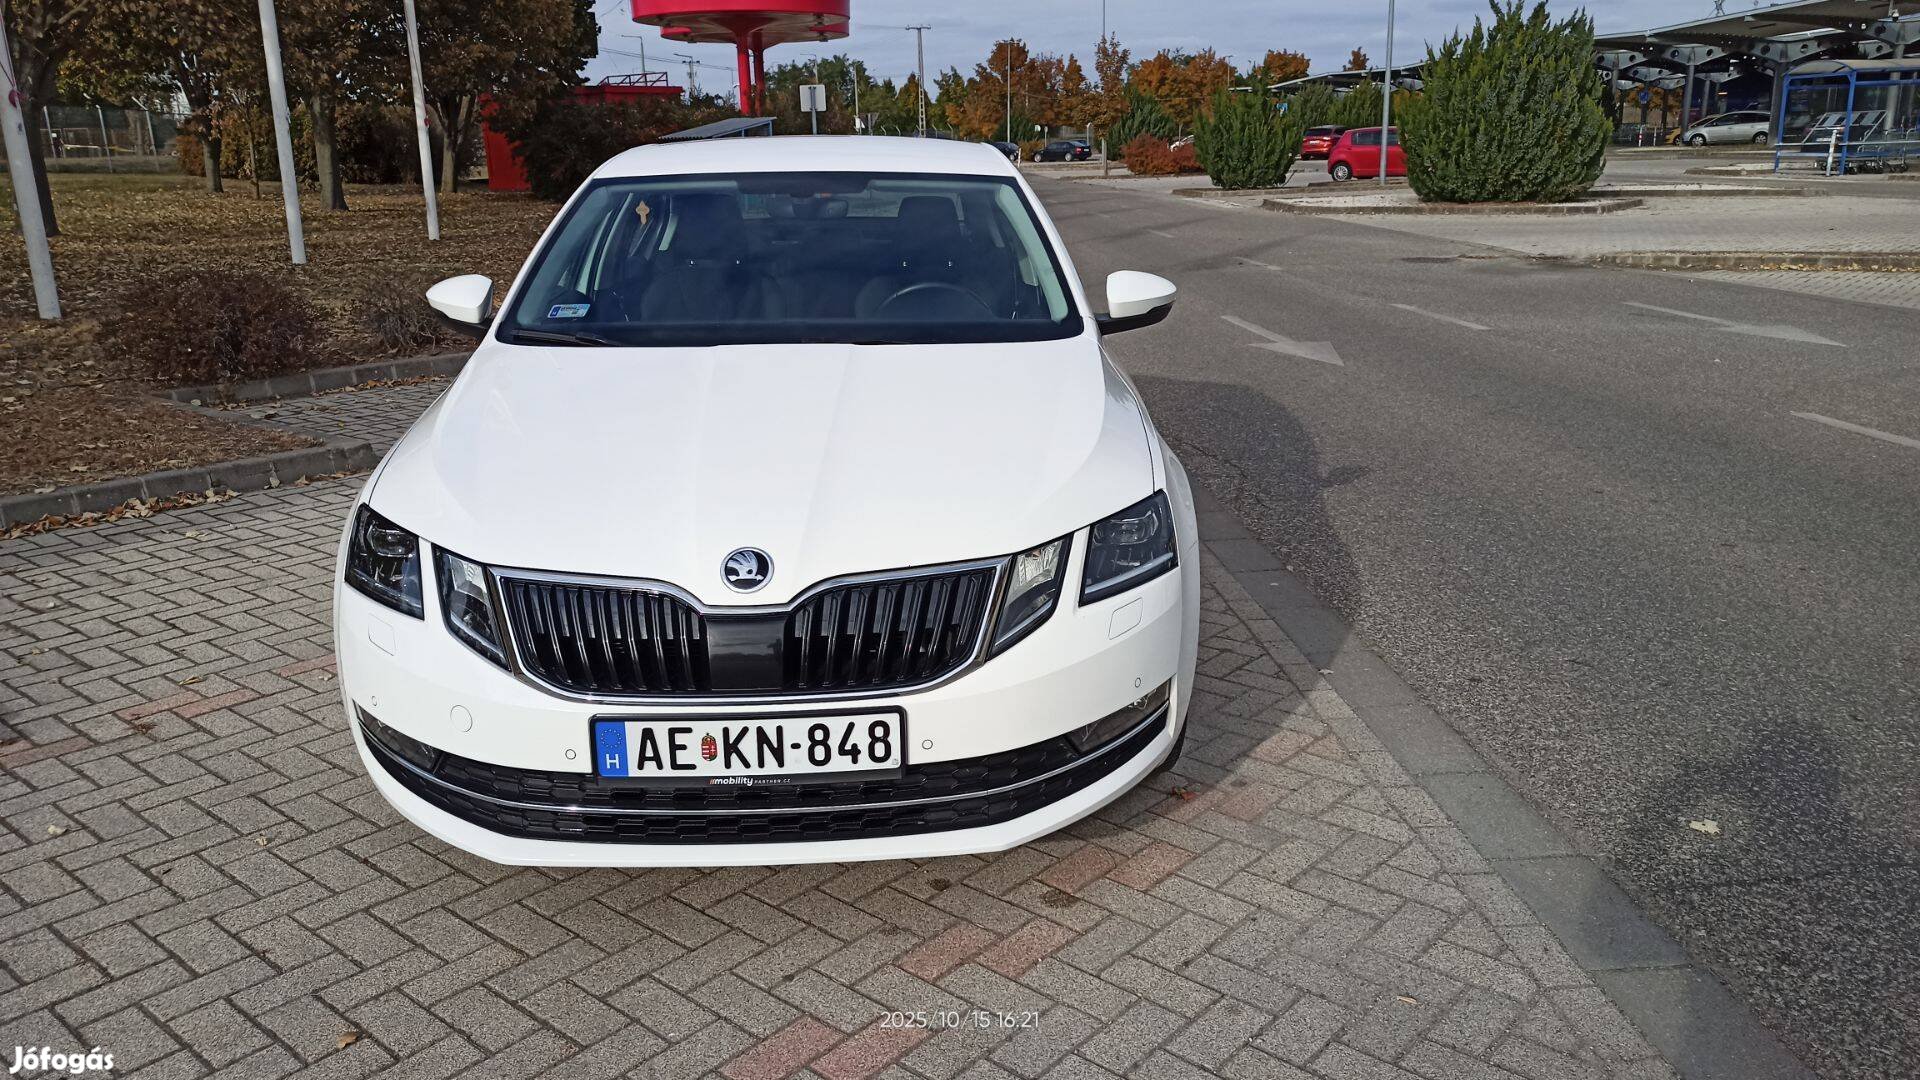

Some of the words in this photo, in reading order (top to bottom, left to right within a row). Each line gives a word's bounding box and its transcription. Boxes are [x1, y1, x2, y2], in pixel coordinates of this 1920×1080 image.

[637, 727, 697, 771] AE
[722, 720, 892, 770] KN-848
[606, 753, 620, 769] H
[714, 777, 753, 786] mobility
